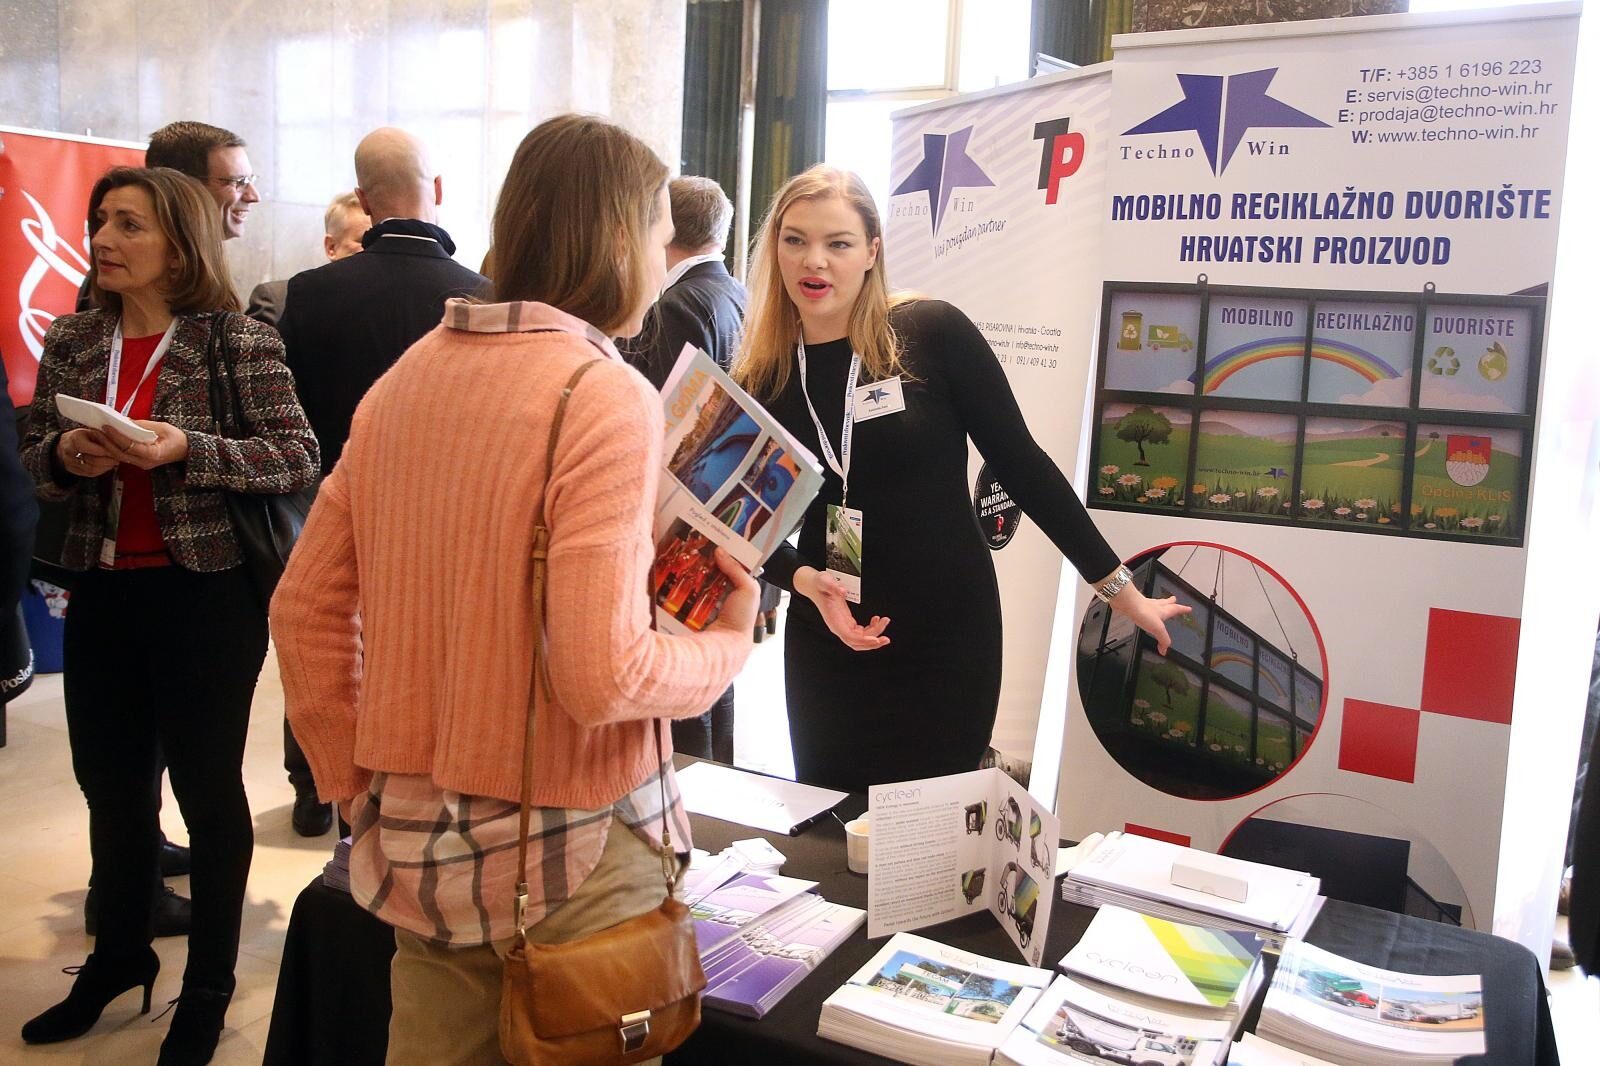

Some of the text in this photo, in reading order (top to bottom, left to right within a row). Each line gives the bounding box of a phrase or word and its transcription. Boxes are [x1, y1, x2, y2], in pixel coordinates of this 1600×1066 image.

[1360, 59, 1542, 83] T/F: +385 1 6196 223
[1346, 80, 1553, 104] E: servis@techno-win.hr
[1338, 100, 1559, 126] E: prodaja@techno-win.hr
[1352, 124, 1540, 144] W: www.techno-win.hr
[1120, 140, 1290, 160] Techno Win
[889, 197, 974, 217] Techno Win
[1111, 182, 1552, 221] MOBILNO RECIKLAŽNO DVORIŠTE
[1179, 236, 1451, 265] HRVATSKI PROIZVOD
[1041, 326, 1062, 337] Croatia
[1221, 307, 1515, 337] MOBILNO RECIKLAŽNO DVORIŠTE
[980, 491, 1009, 508] WARRAN
[992, 499, 1016, 514] STANDAR
[876, 787, 921, 804] cyclean
[1085, 951, 1179, 985] cyclean
